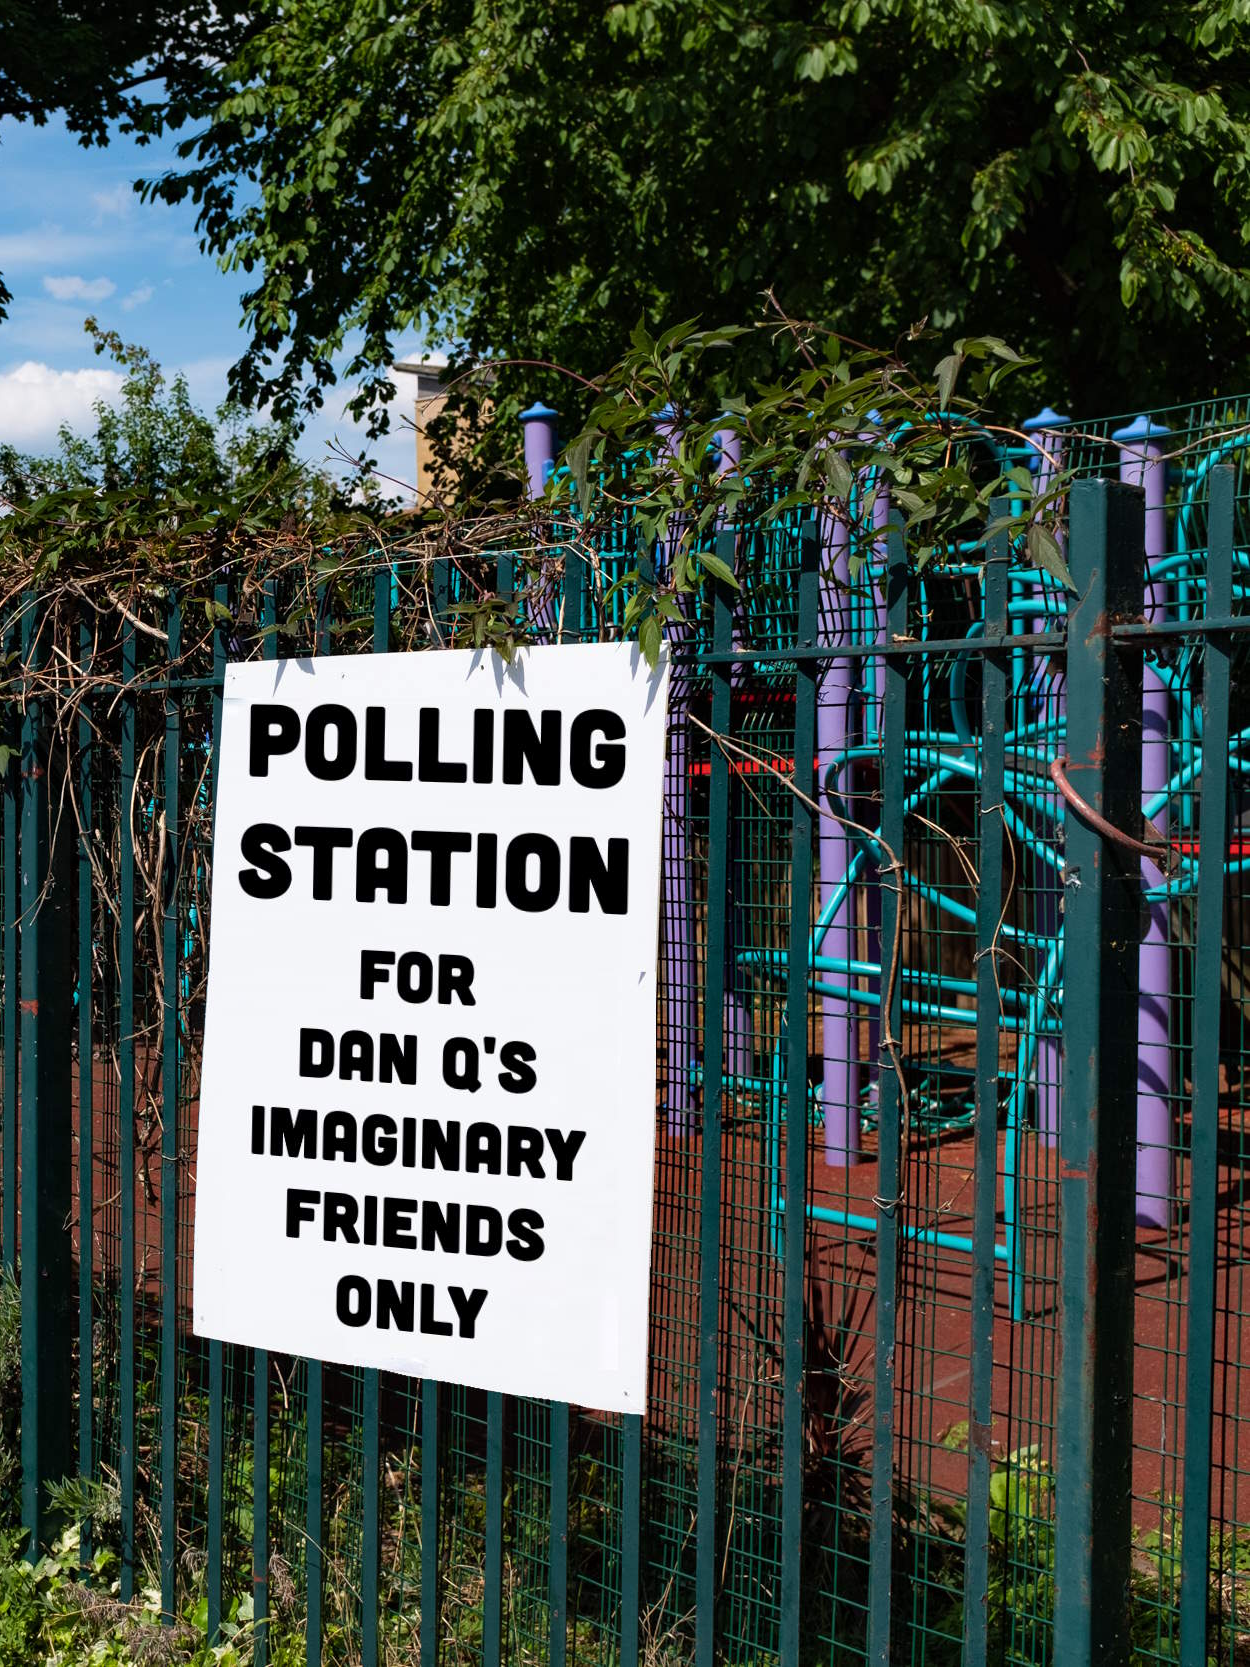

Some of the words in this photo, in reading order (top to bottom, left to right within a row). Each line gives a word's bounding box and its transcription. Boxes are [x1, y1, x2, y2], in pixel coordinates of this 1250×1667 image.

[249, 703, 627, 790] POLLING
[238, 822, 629, 915] STATION
[360, 949, 476, 1007] FOR
[299, 1027, 418, 1086] DAN
[442, 1036, 537, 1094] Q'S
[251, 1105, 587, 1182] IMAGINARY
[285, 1188, 545, 1262] FRIENDS
[336, 1274, 489, 1339] ONLY
